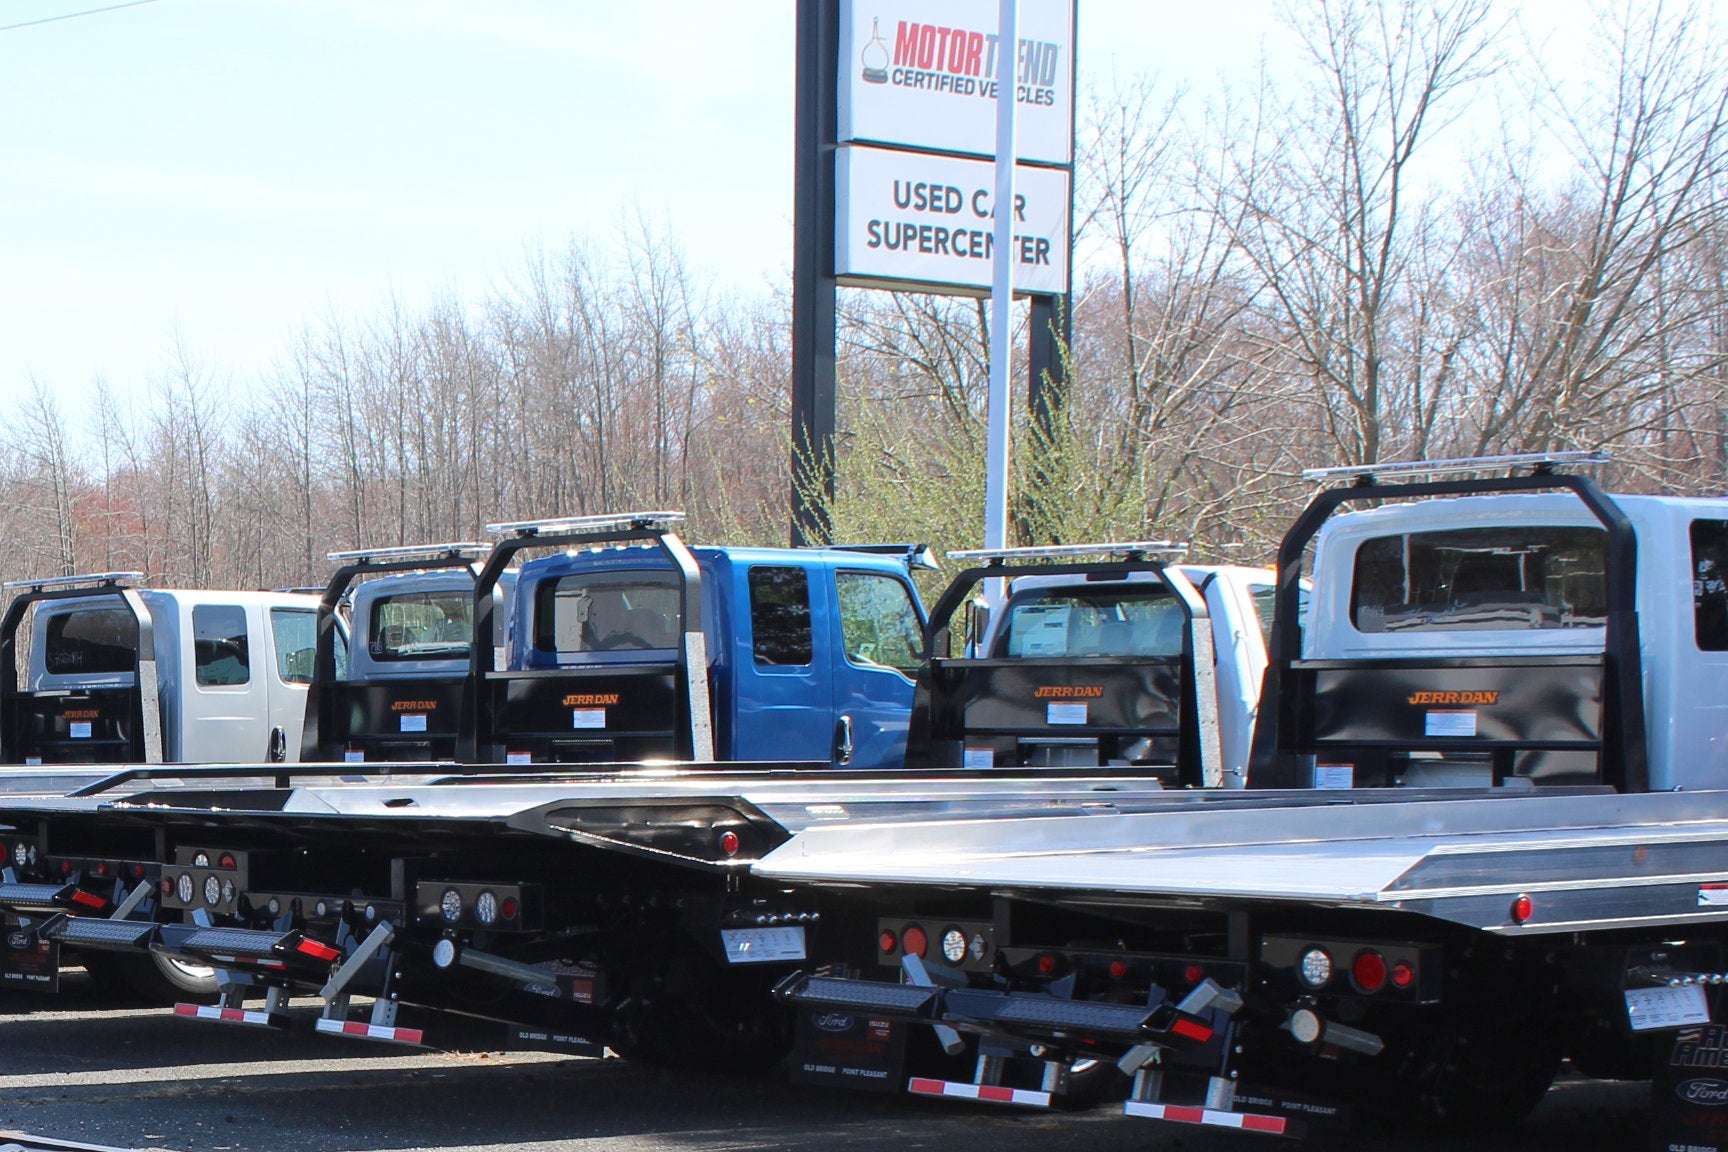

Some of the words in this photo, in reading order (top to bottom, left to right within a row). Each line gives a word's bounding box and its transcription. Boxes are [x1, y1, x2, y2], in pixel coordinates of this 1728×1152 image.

[893, 21, 1058, 87] MOTORTEND
[892, 69, 975, 96] CERTIFIED
[979, 80, 1055, 107] VECLES
[893, 180, 962, 214] USED
[971, 189, 1026, 222] CR
[818, 1013, 848, 1027] Ford
[815, 1065, 836, 1074] BRIDGE
[842, 1067, 859, 1075] POINT
[859, 1068, 888, 1079] PLEASANT
[1685, 1080, 1728, 1102] Ford
[1248, 1096, 1273, 1107] BRIDGE
[1281, 1101, 1302, 1110] POINT
[1302, 1103, 1337, 1115] PLEASANT
[1668, 1144, 1686, 1152] OLD
